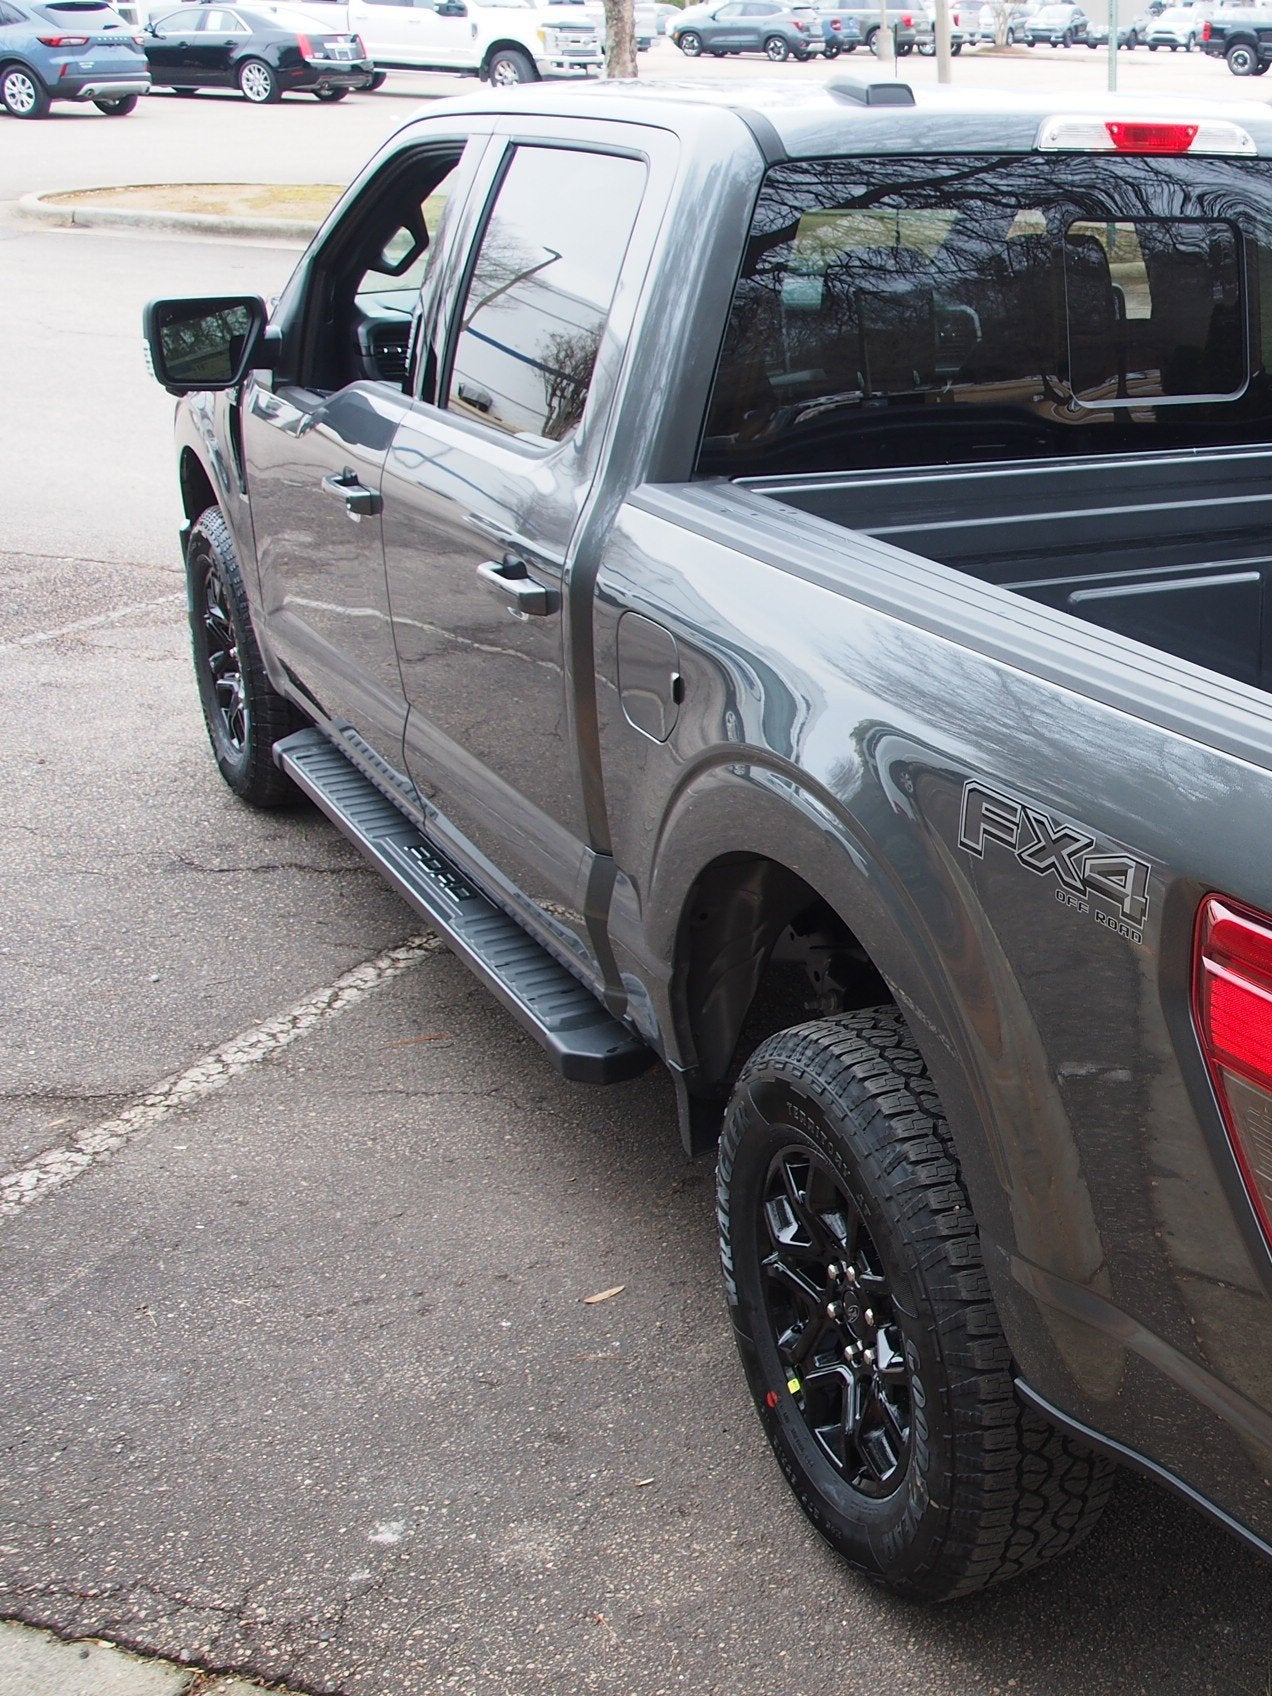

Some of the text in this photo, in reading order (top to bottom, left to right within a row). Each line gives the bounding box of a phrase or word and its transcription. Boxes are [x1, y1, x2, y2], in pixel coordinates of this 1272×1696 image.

[958, 778, 1151, 929] FX4
[1055, 888, 1142, 945] OFF ROAD
